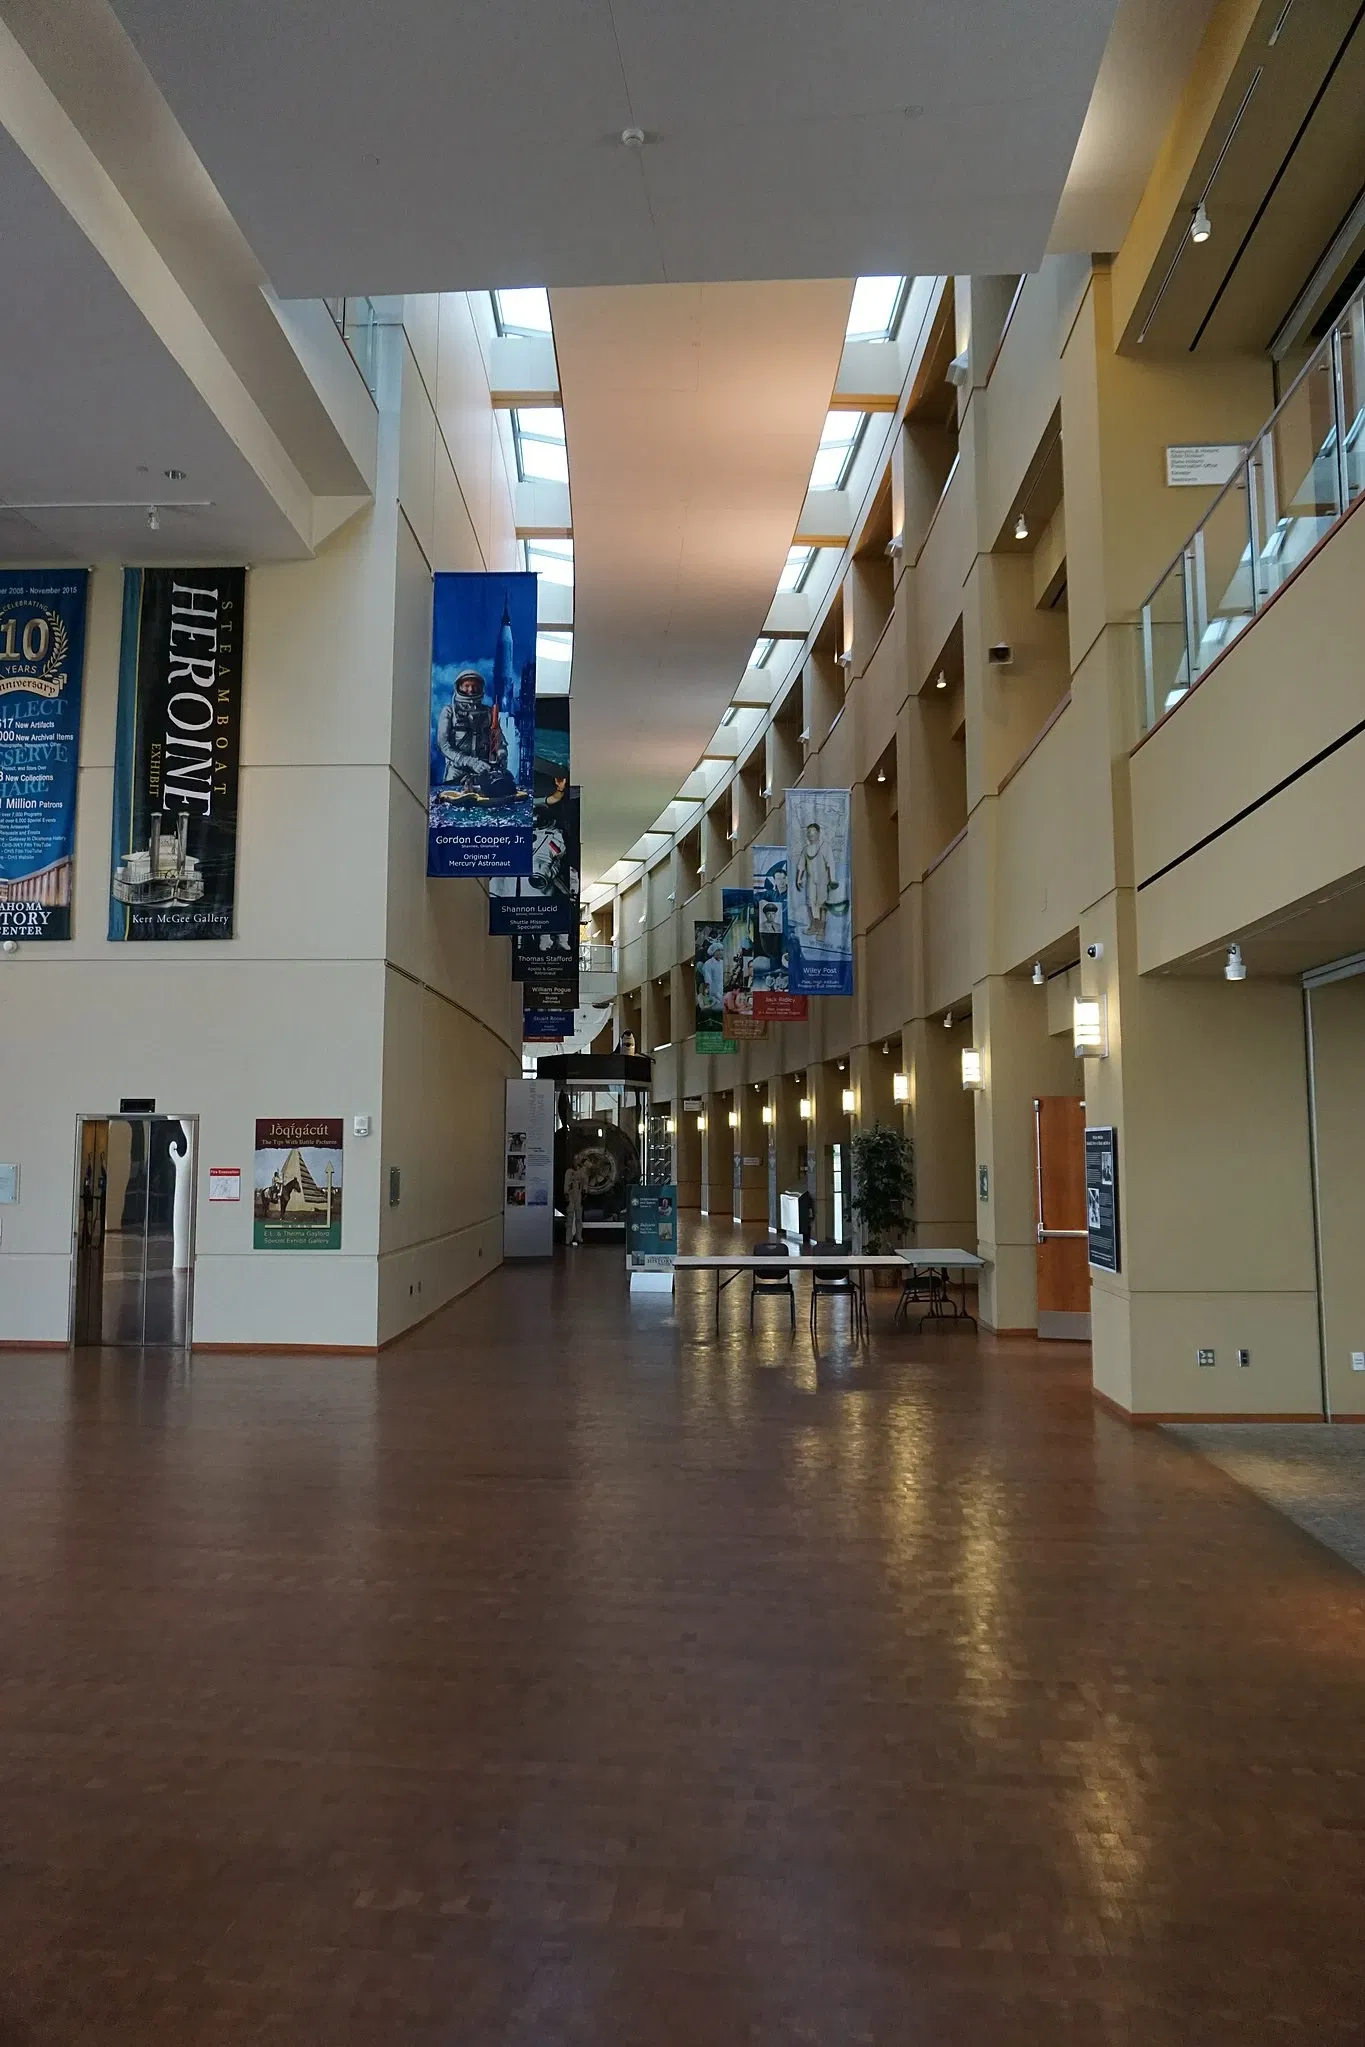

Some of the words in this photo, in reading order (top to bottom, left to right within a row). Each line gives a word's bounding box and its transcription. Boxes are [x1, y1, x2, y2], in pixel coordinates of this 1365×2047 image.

[62, 586, 78, 594] 2015
[3, 600, 49, 612] CELEBRATING
[0, 618, 50, 661] 10
[5, 665, 38, 674] YEARS
[162, 581, 219, 817] HEROINE
[214, 601, 234, 795] STEAMBOAT
[31, 732, 55, 740] Archival
[149, 743, 161, 797] EXHIBIT
[6, 798, 37, 809] Million
[39, 800, 63, 808] Patrons
[435, 835, 471, 844] Gordon
[474, 835, 511, 845] Cooper,
[514, 835, 525, 844] Jr.
[132, 914, 152, 923] Kerr
[156, 914, 189, 923] McGee
[193, 914, 228, 925] Gallery
